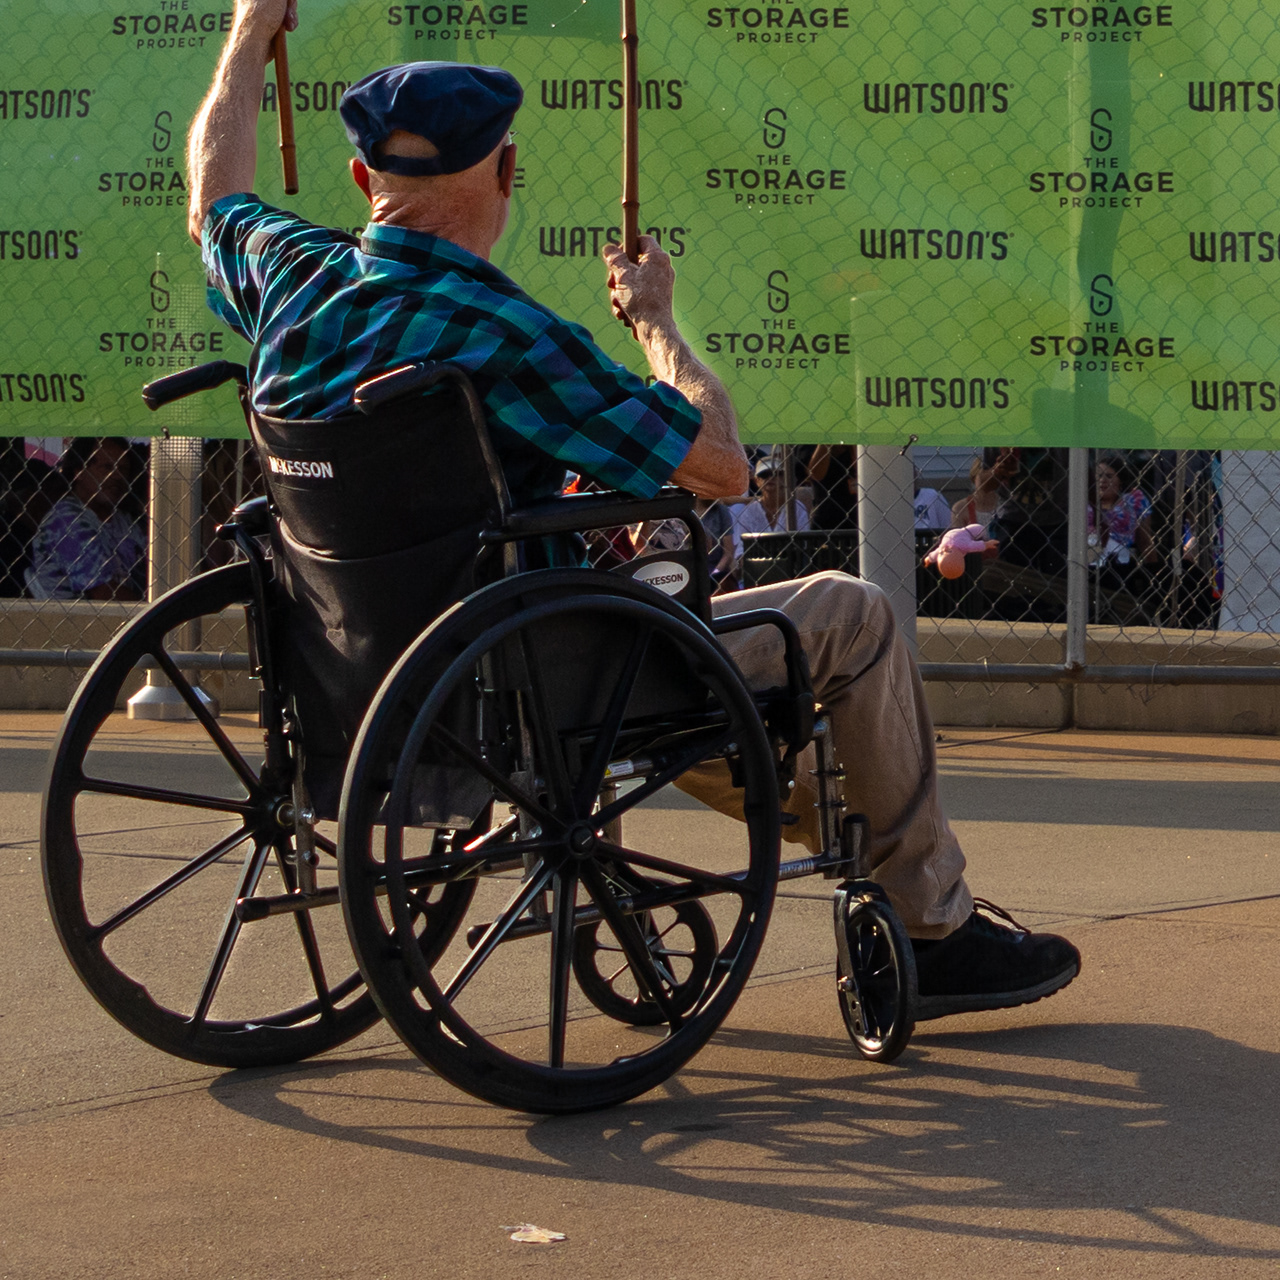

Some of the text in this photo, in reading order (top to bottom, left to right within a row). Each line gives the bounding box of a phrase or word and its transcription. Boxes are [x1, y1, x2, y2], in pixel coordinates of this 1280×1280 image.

[161, 0, 188, 11] THE
[389, 5, 527, 25] STORAGE
[707, 8, 848, 28] STORAGE
[1032, 6, 1172, 27] STORAGE
[112, 13, 233, 35] STORAGE
[415, 29, 497, 40] PROJECT
[737, 32, 817, 43] PROJECT
[1062, 31, 1142, 42] PROJECT
[137, 37, 205, 49] PROJECT
[864, 83, 1008, 113] WATSON'S
[146, 157, 174, 168] THE
[757, 155, 790, 165] THE
[1085, 158, 1118, 168] THE
[98, 171, 185, 192] STORA
[706, 169, 845, 189] STORAGE
[1030, 172, 1173, 192] STORAGE
[123, 196, 184, 206] PROJEC
[735, 194, 814, 204] PROJECT
[1060, 197, 1142, 208] PROJECT
[860, 229, 1008, 260] WATSON'S
[146, 318, 175, 328] THE
[761, 319, 795, 329] THE
[1084, 323, 1118, 333] THE
[99, 332, 223, 352] STORAGE
[706, 333, 850, 354] STORAGE
[1031, 336, 1174, 357] STORAGE
[125, 357, 195, 367] PROJECT
[736, 358, 819, 369] PROJECT
[1061, 361, 1144, 372] PROJECT
[866, 377, 1008, 409] WATSON'S
